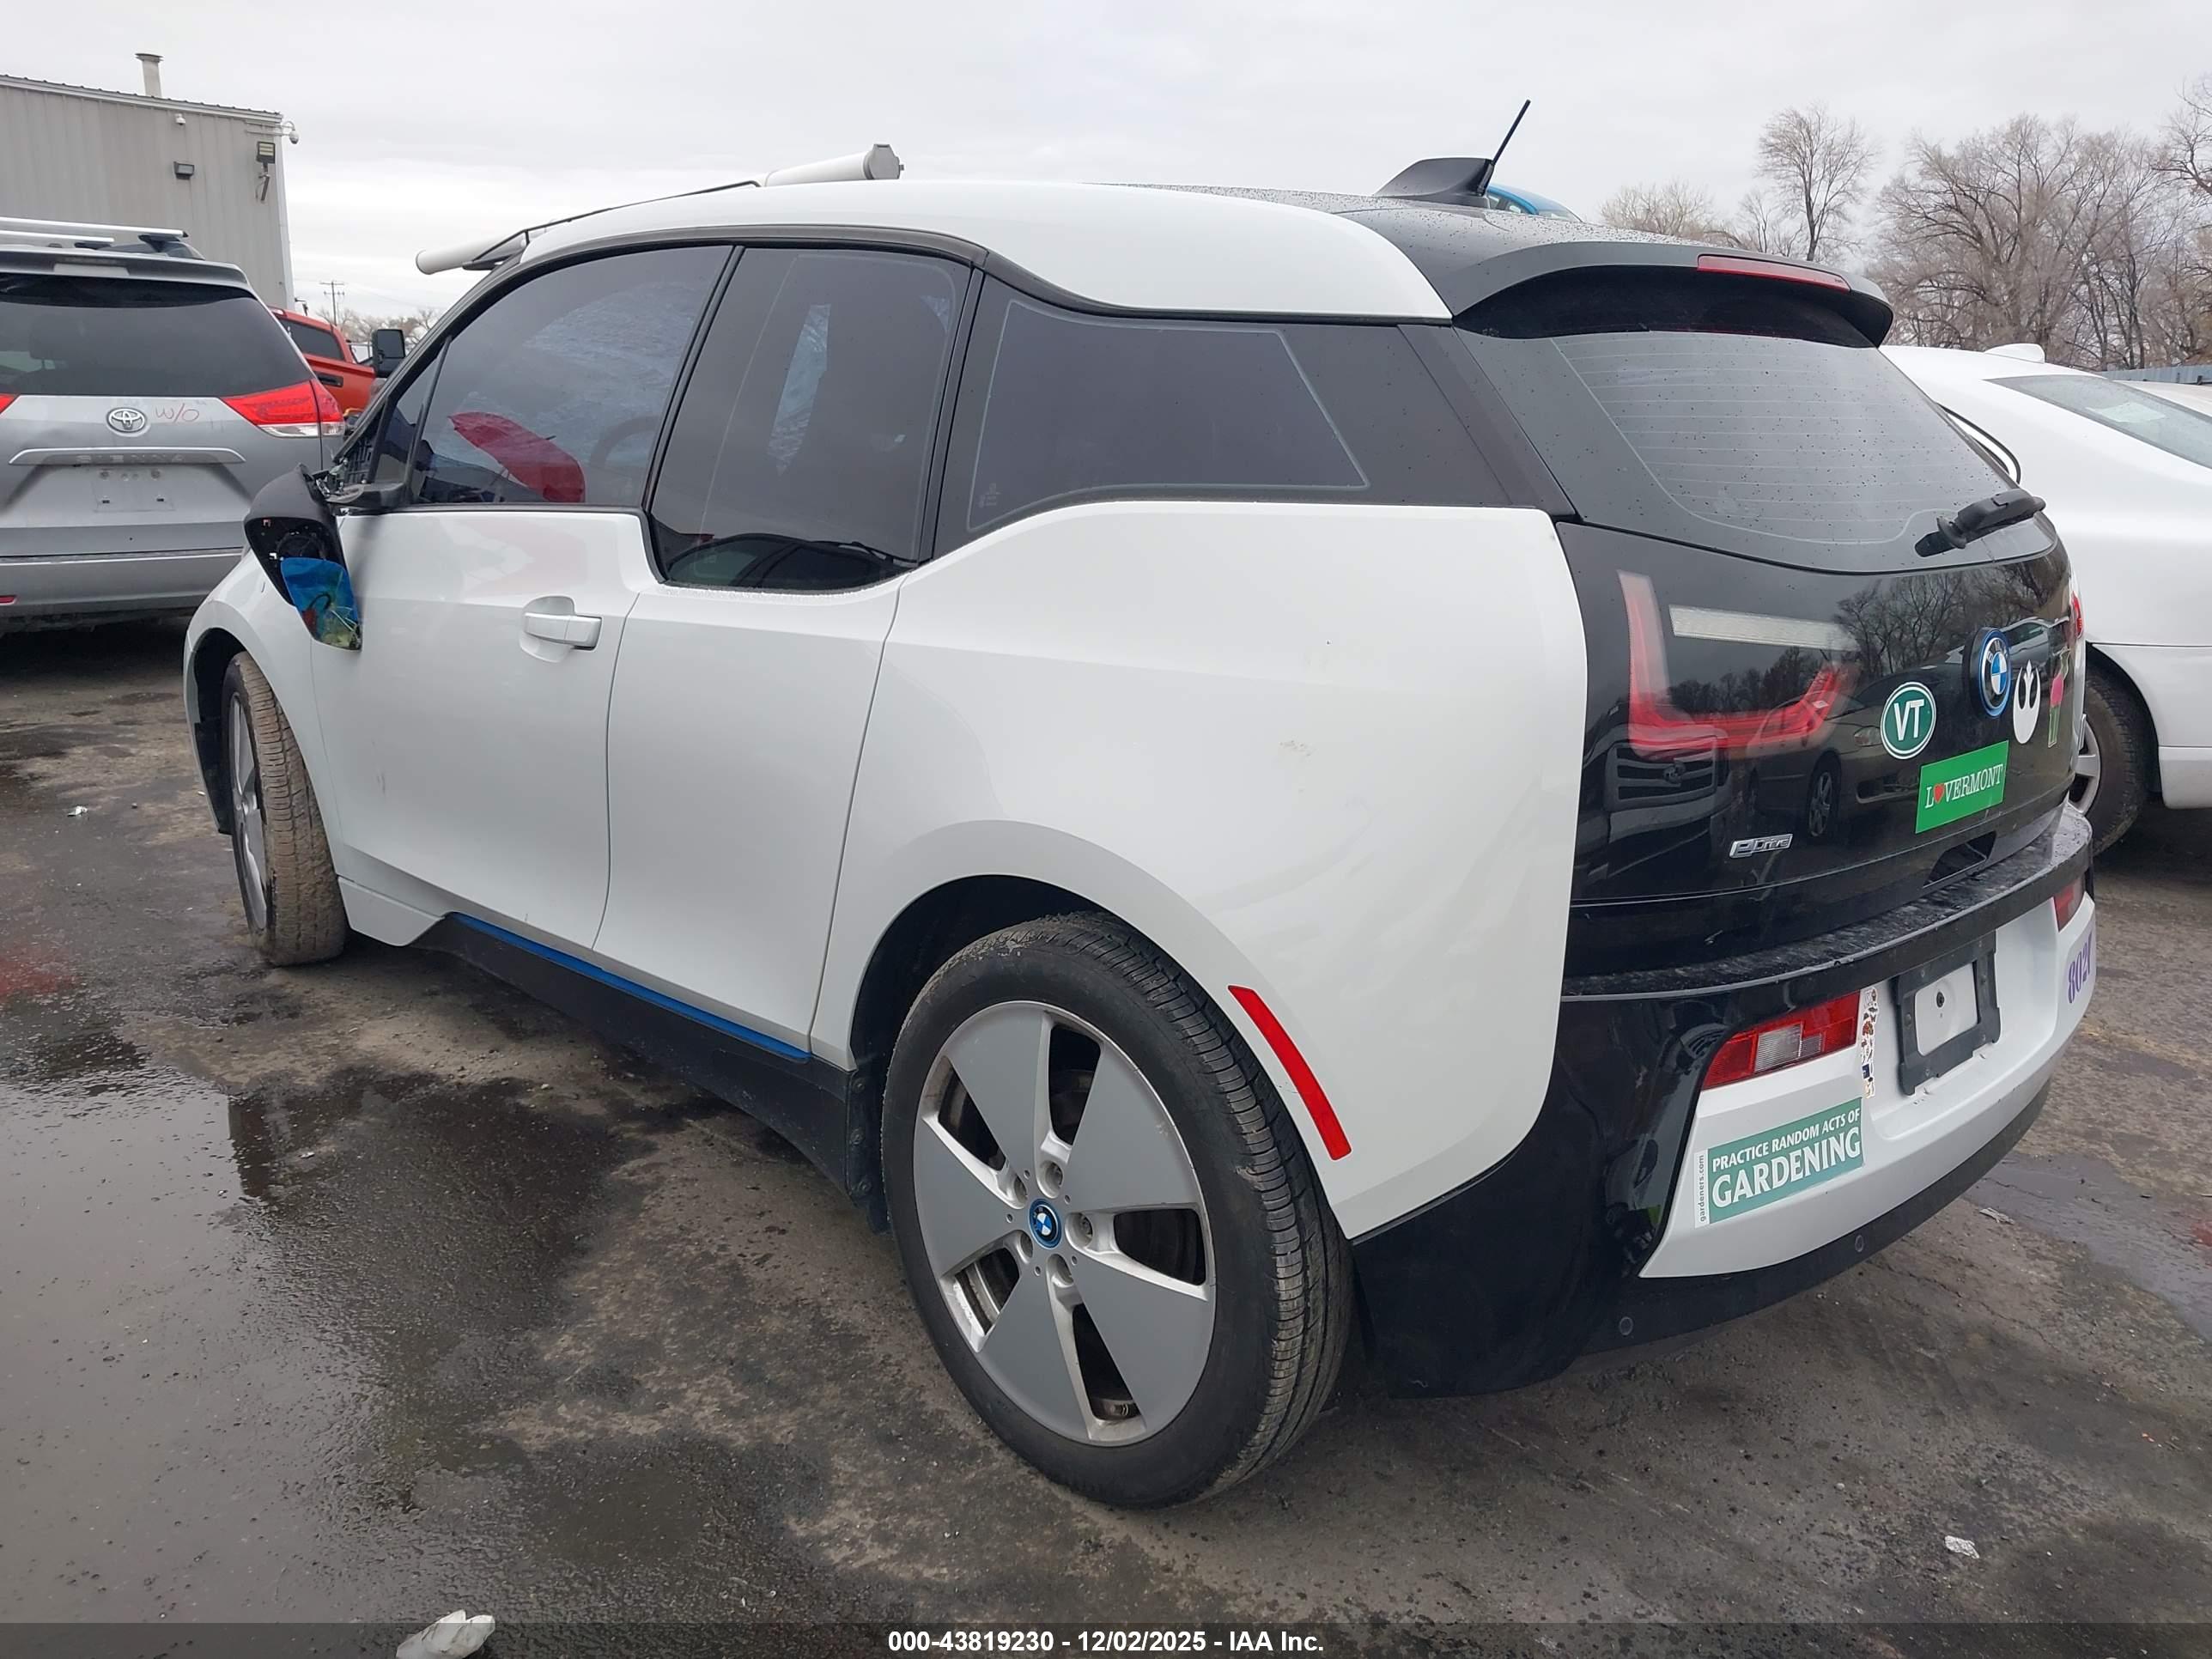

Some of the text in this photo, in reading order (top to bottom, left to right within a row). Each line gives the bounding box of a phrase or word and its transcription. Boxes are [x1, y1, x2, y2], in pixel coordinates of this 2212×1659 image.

[1893, 698, 1925, 741] VT
[1711, 1126, 1862, 1209] GARDENING
[1712, 1108, 1861, 1173] PRACTICE RANDOM ACTS OF
[1698, 1154, 1707, 1222] gardeners.com
